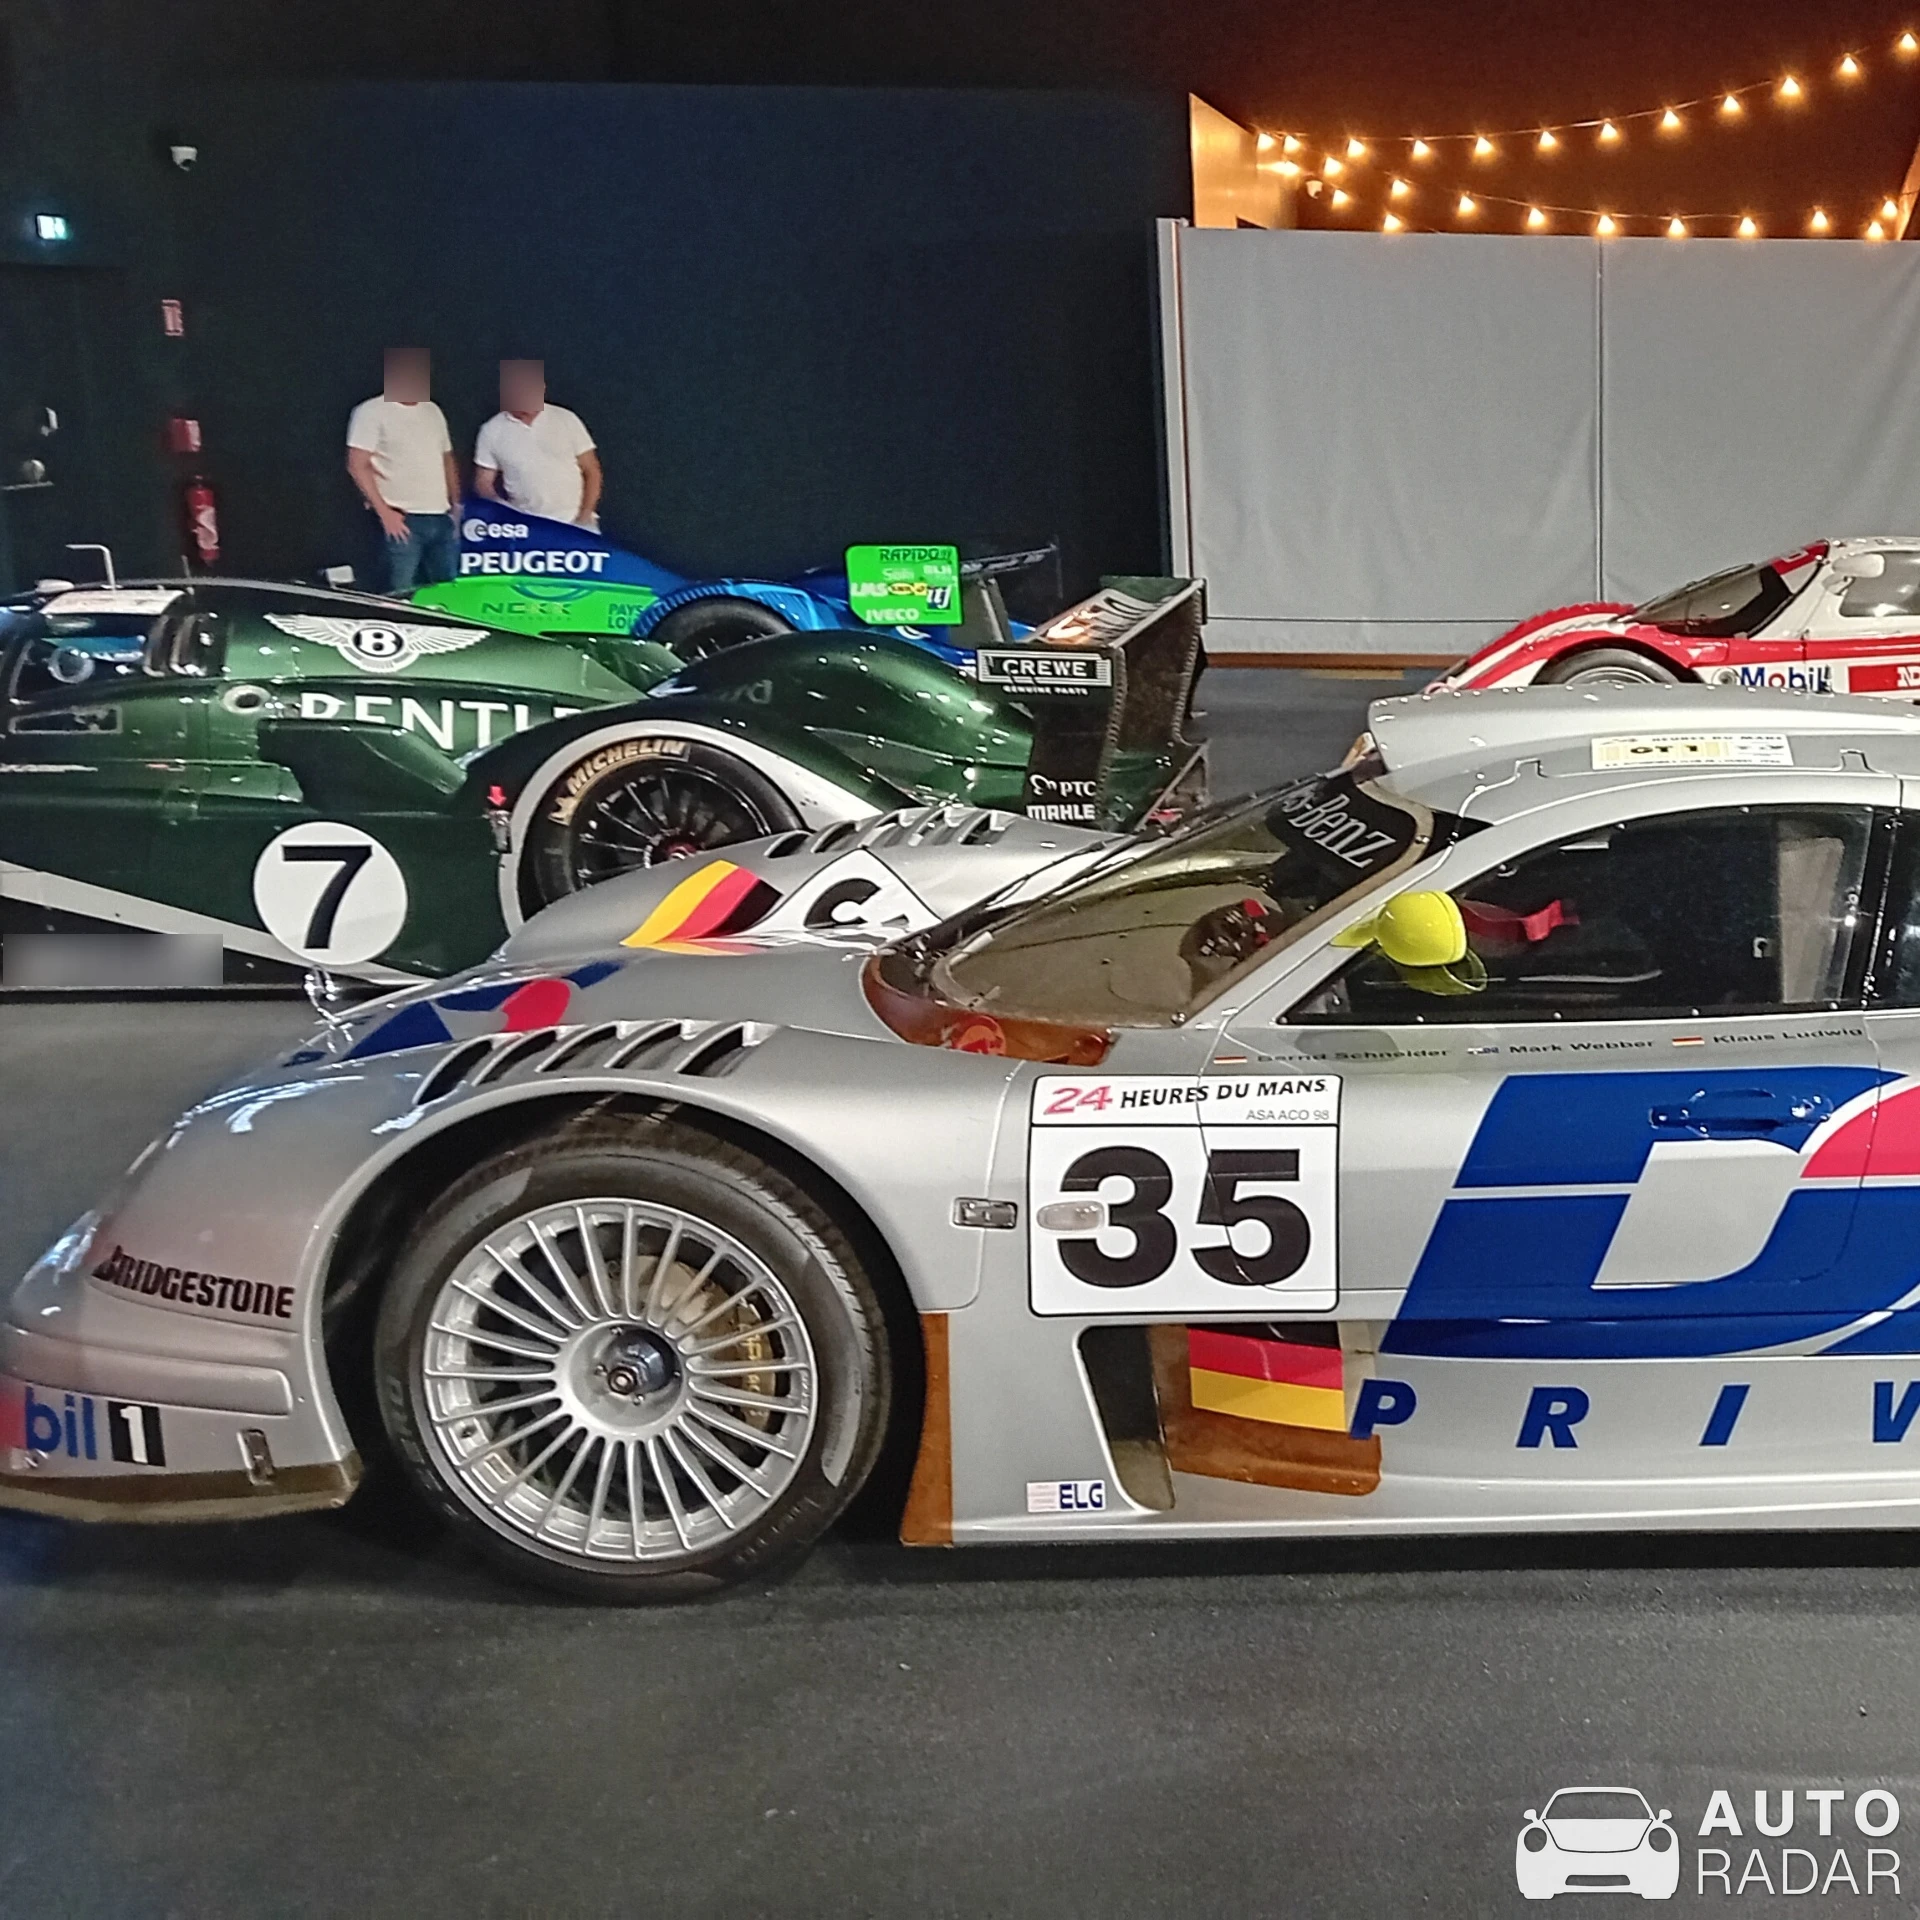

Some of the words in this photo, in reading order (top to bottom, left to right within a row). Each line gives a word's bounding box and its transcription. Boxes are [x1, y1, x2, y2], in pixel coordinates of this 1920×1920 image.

[460, 550, 611, 574] PEUGEOT
[608, 616, 636, 629] LOI
[866, 608, 920, 623] IVECO
[358, 629, 398, 656] B
[1002, 659, 1088, 677] CREWE
[300, 692, 583, 750] BENTL
[566, 739, 688, 793] MICHELIN
[1059, 780, 1097, 797] PTC
[1026, 803, 1096, 821] MAHLE
[1281, 782, 1396, 869] s-Benz
[281, 844, 372, 950] 7
[1509, 1044, 1561, 1054] Mark
[1568, 1041, 1654, 1052] Webber
[1713, 1035, 1774, 1044] Klaus
[1783, 1028, 1863, 1040] Ludwig
[1044, 1086, 1113, 1115] 24
[1120, 1086, 1208, 1109] HEURES
[1216, 1083, 1250, 1100] DU
[1257, 1079, 1327, 1097] MANS
[1313, 1109, 1330, 1121] 98
[1057, 1145, 1311, 1288] 35
[91, 1245, 295, 1319] BRIDGESTONE
[20, 1384, 97, 1460] bil
[119, 1405, 148, 1463] 1
[1348, 1378, 1920, 1449] PRIV
[1059, 1482, 1103, 1510] ELG
